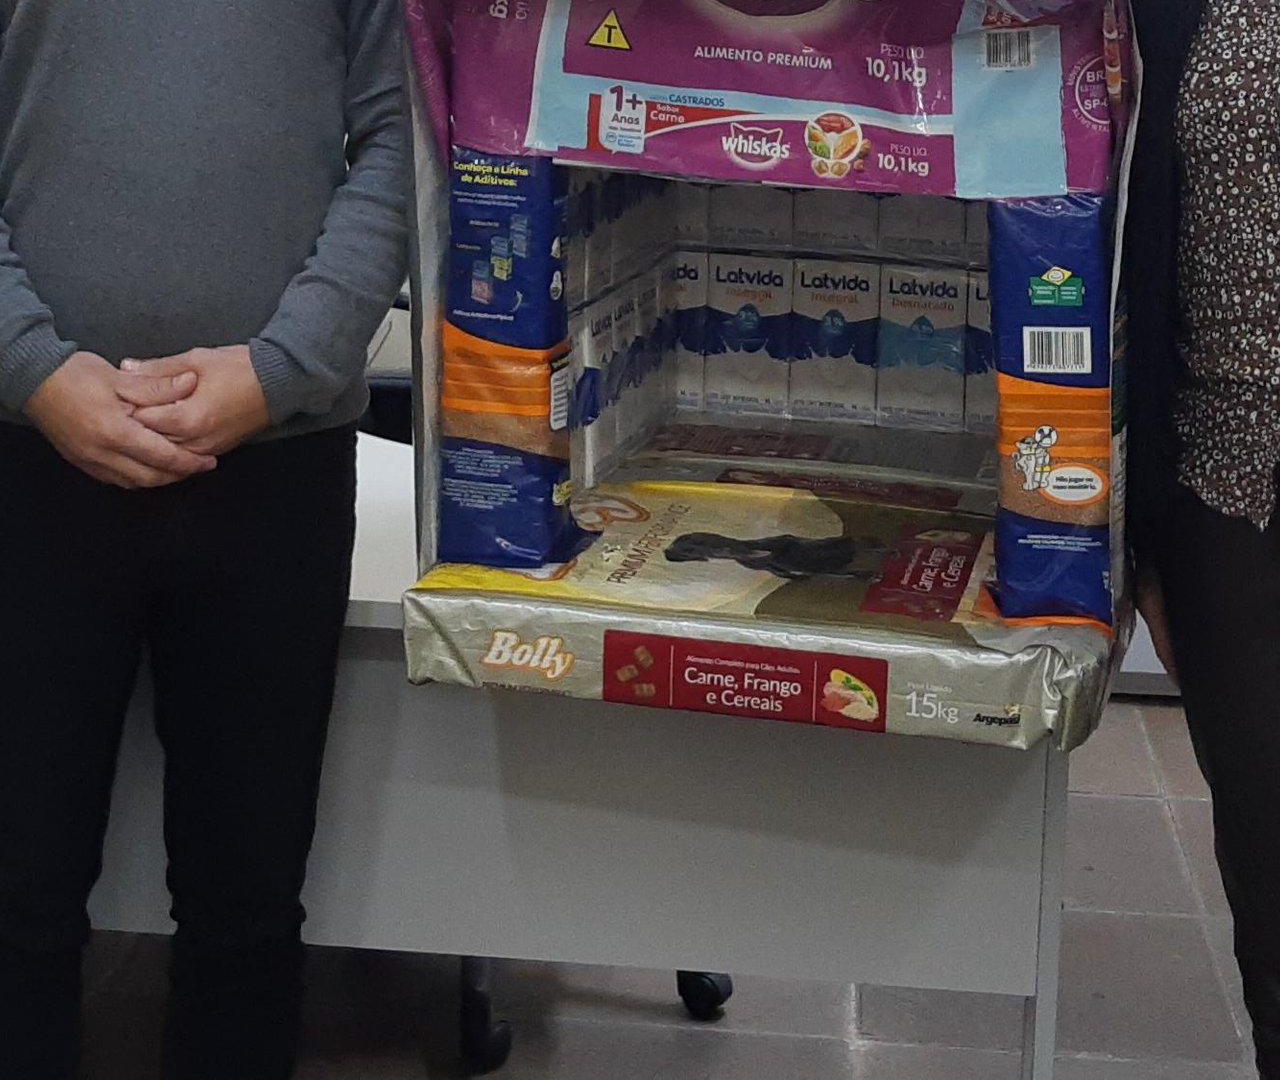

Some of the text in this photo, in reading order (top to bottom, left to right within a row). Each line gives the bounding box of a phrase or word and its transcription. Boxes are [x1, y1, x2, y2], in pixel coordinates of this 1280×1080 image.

[603, 24, 618, 44] T
[694, 45, 832, 70] ALIMENTO PREMIUM
[865, 56, 927, 88] 10,1kg
[669, 94, 725, 107] CASTRADOS
[611, 113, 641, 126] Anos
[721, 136, 790, 159] whiskas
[877, 153, 930, 177] 10,1kg
[715, 266, 784, 288] Latvida
[800, 271, 870, 291] Latvida
[889, 276, 959, 299] Latvida
[481, 629, 575, 681] Bolly
[684, 667, 801, 697] Carne, Frango
[706, 690, 783, 712] e Cereais
[905, 691, 959, 724] 15kg
